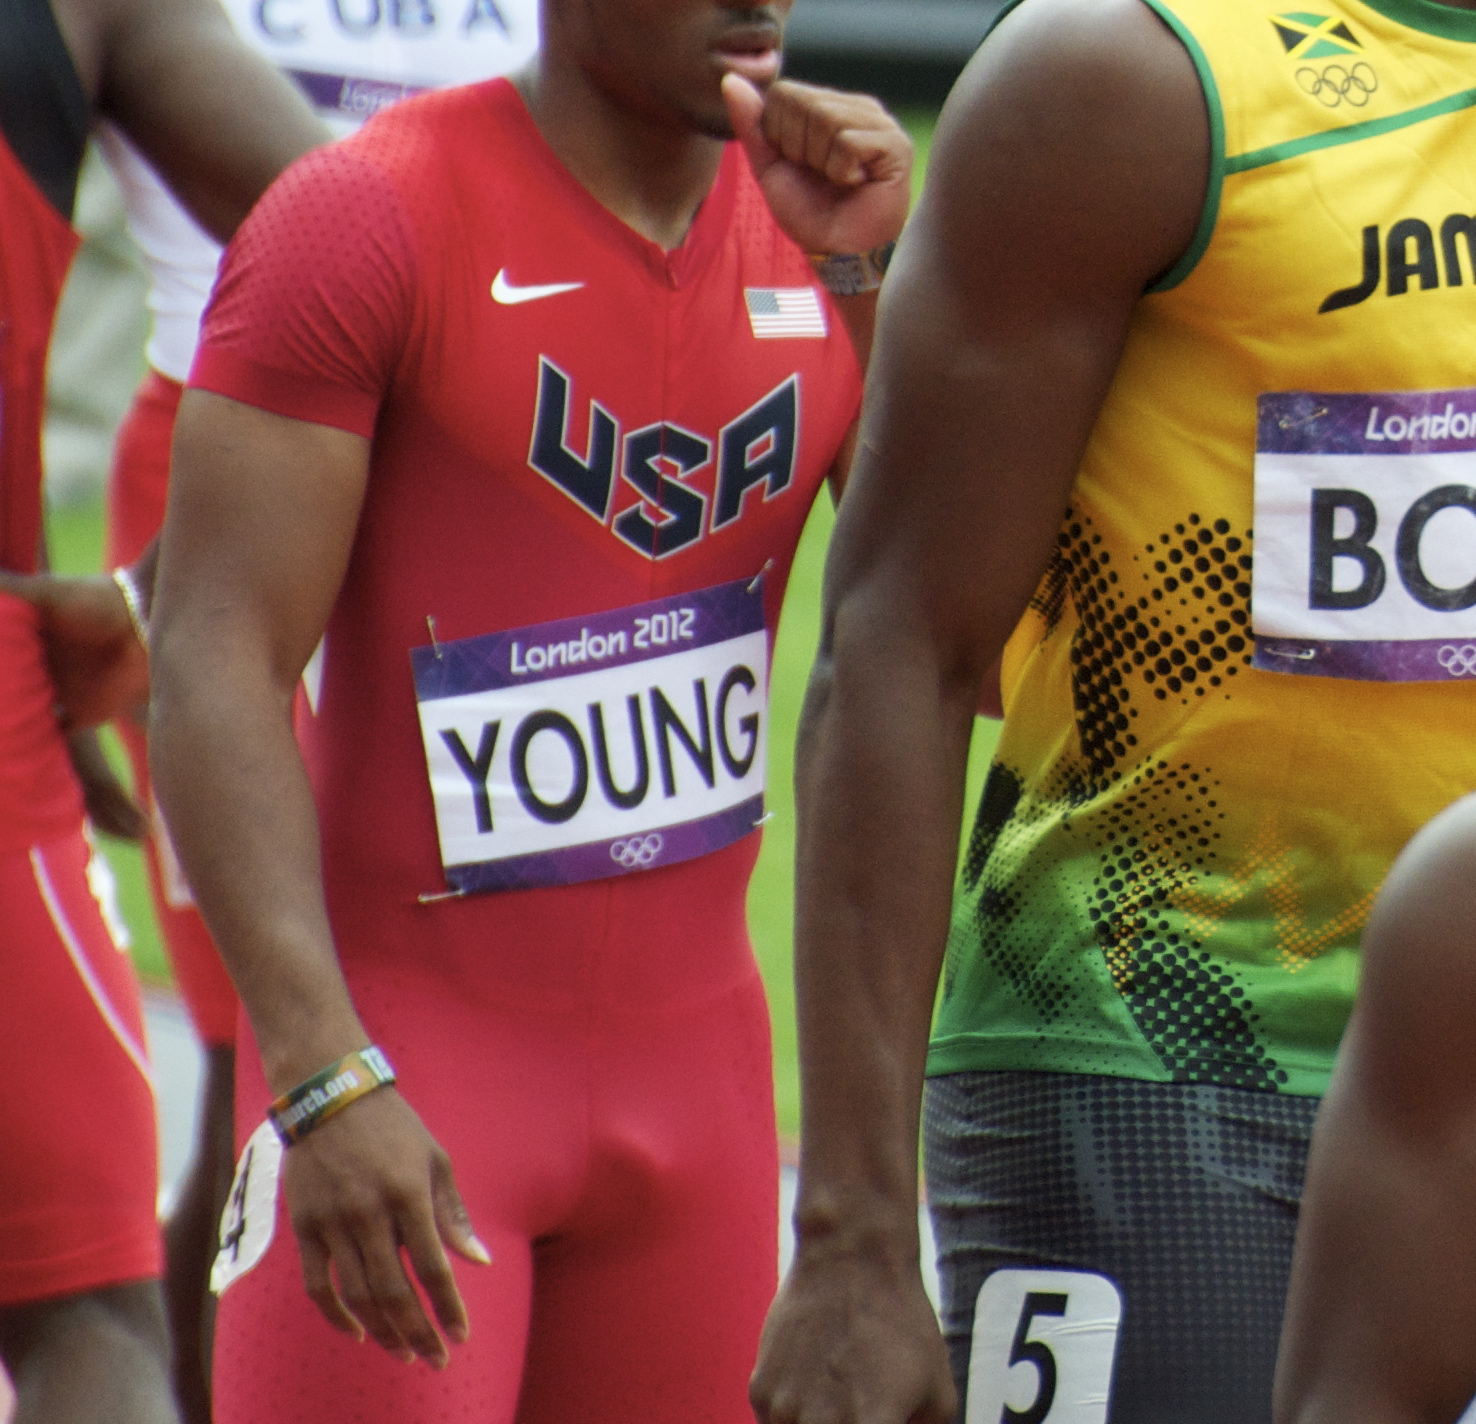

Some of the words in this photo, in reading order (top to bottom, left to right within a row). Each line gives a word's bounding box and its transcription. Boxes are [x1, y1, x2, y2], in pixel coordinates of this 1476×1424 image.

[527, 353, 801, 562] USA
[510, 627, 626, 675] London
[633, 607, 696, 648] 2012
[437, 664, 761, 835] YOUNG
[1000, 1291, 1069, 1424] 5
